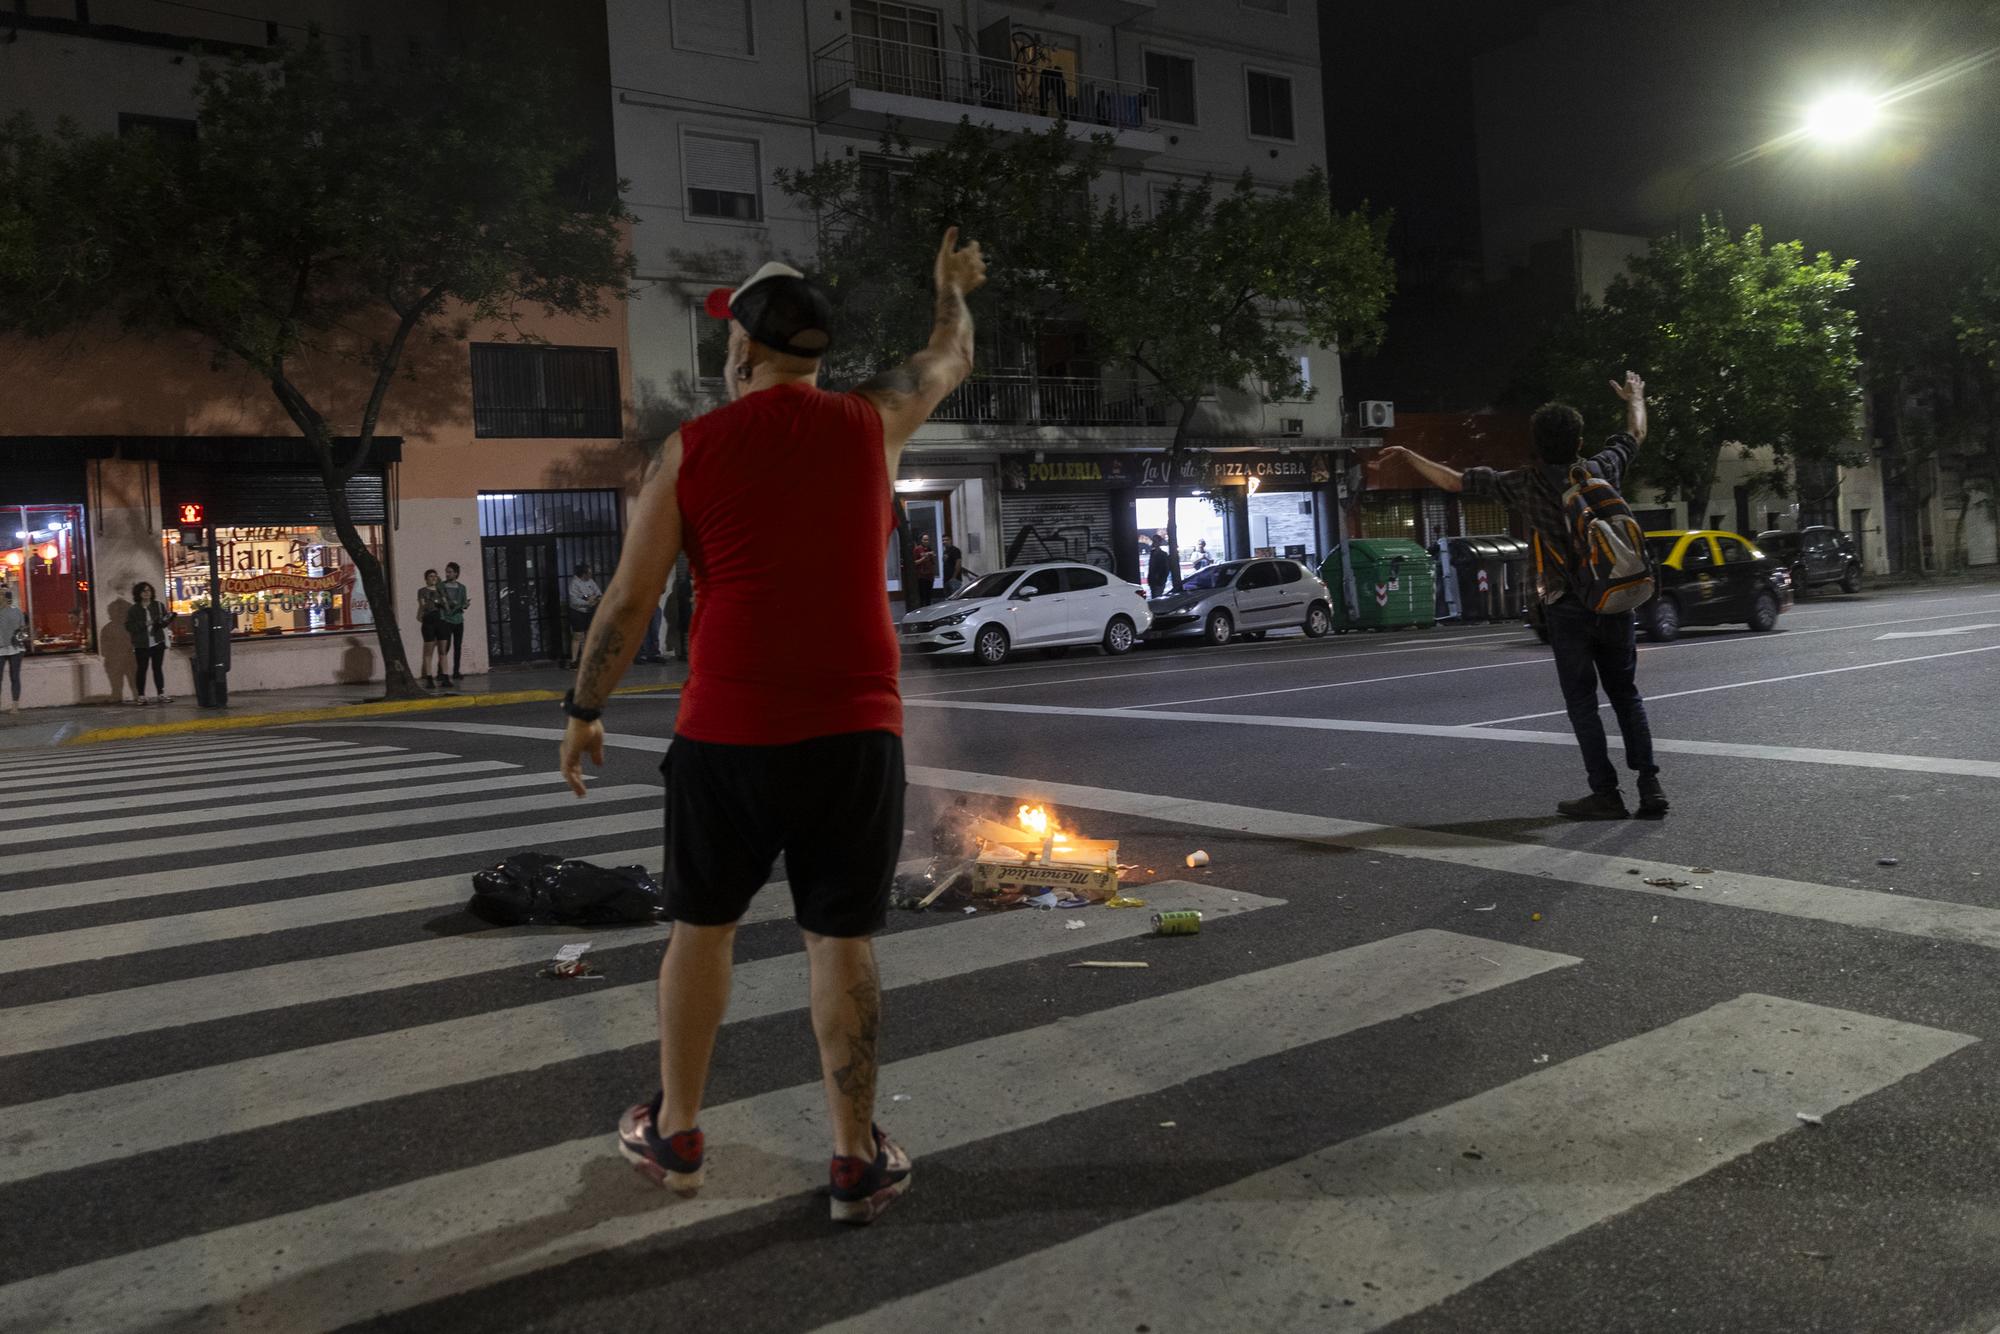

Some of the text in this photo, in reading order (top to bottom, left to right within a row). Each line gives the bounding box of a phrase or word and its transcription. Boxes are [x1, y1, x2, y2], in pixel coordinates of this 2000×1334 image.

[1028, 463, 1102, 481] POLLERIA
[1214, 462, 1306, 476] PIZZA CASERA
[227, 575, 337, 592] COCINA INTERNACIONAL
[997, 867, 1089, 885] Manantial
